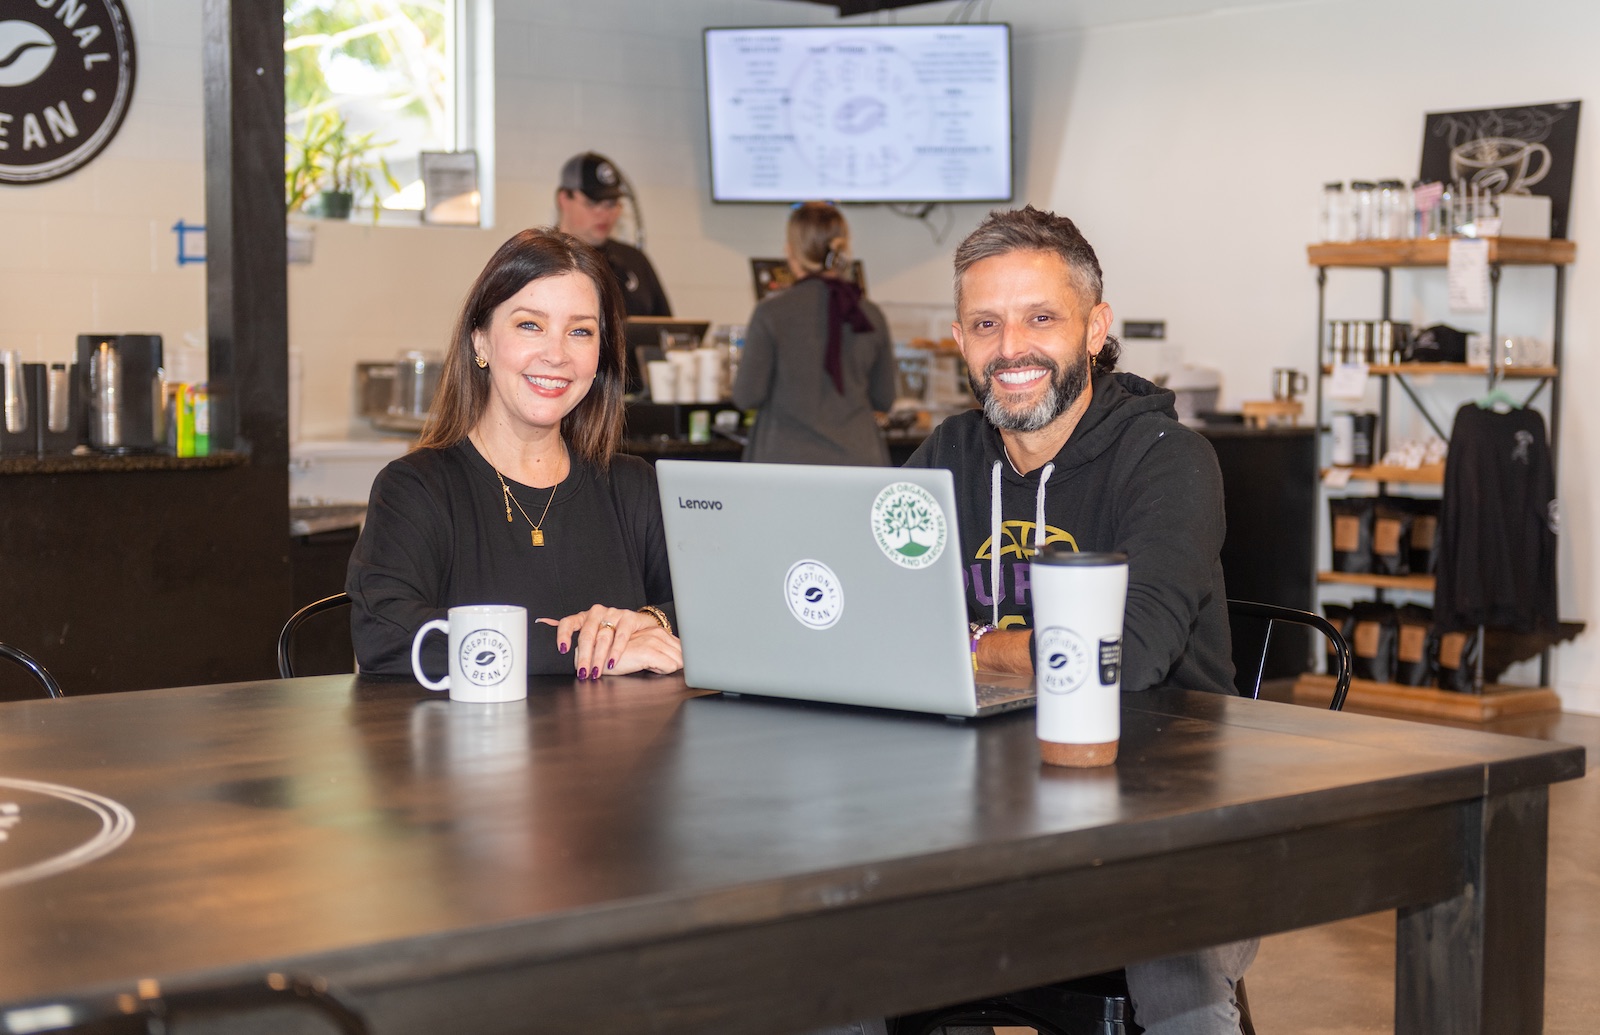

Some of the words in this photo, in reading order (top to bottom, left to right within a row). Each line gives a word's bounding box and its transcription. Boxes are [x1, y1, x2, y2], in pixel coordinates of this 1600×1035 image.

[35, 0, 110, 71] NAL
[678, 496, 723, 511] Lenovo
[875, 486, 895, 511] MAINE
[897, 485, 934, 507] ORGANIC
[901, 557, 920, 567] AND
[791, 572, 836, 599] EXCEPTIONAL
[803, 607, 830, 620] BEAN
[462, 637, 509, 661] EXCEPTIONAL
[472, 669, 501, 681] BEAN
